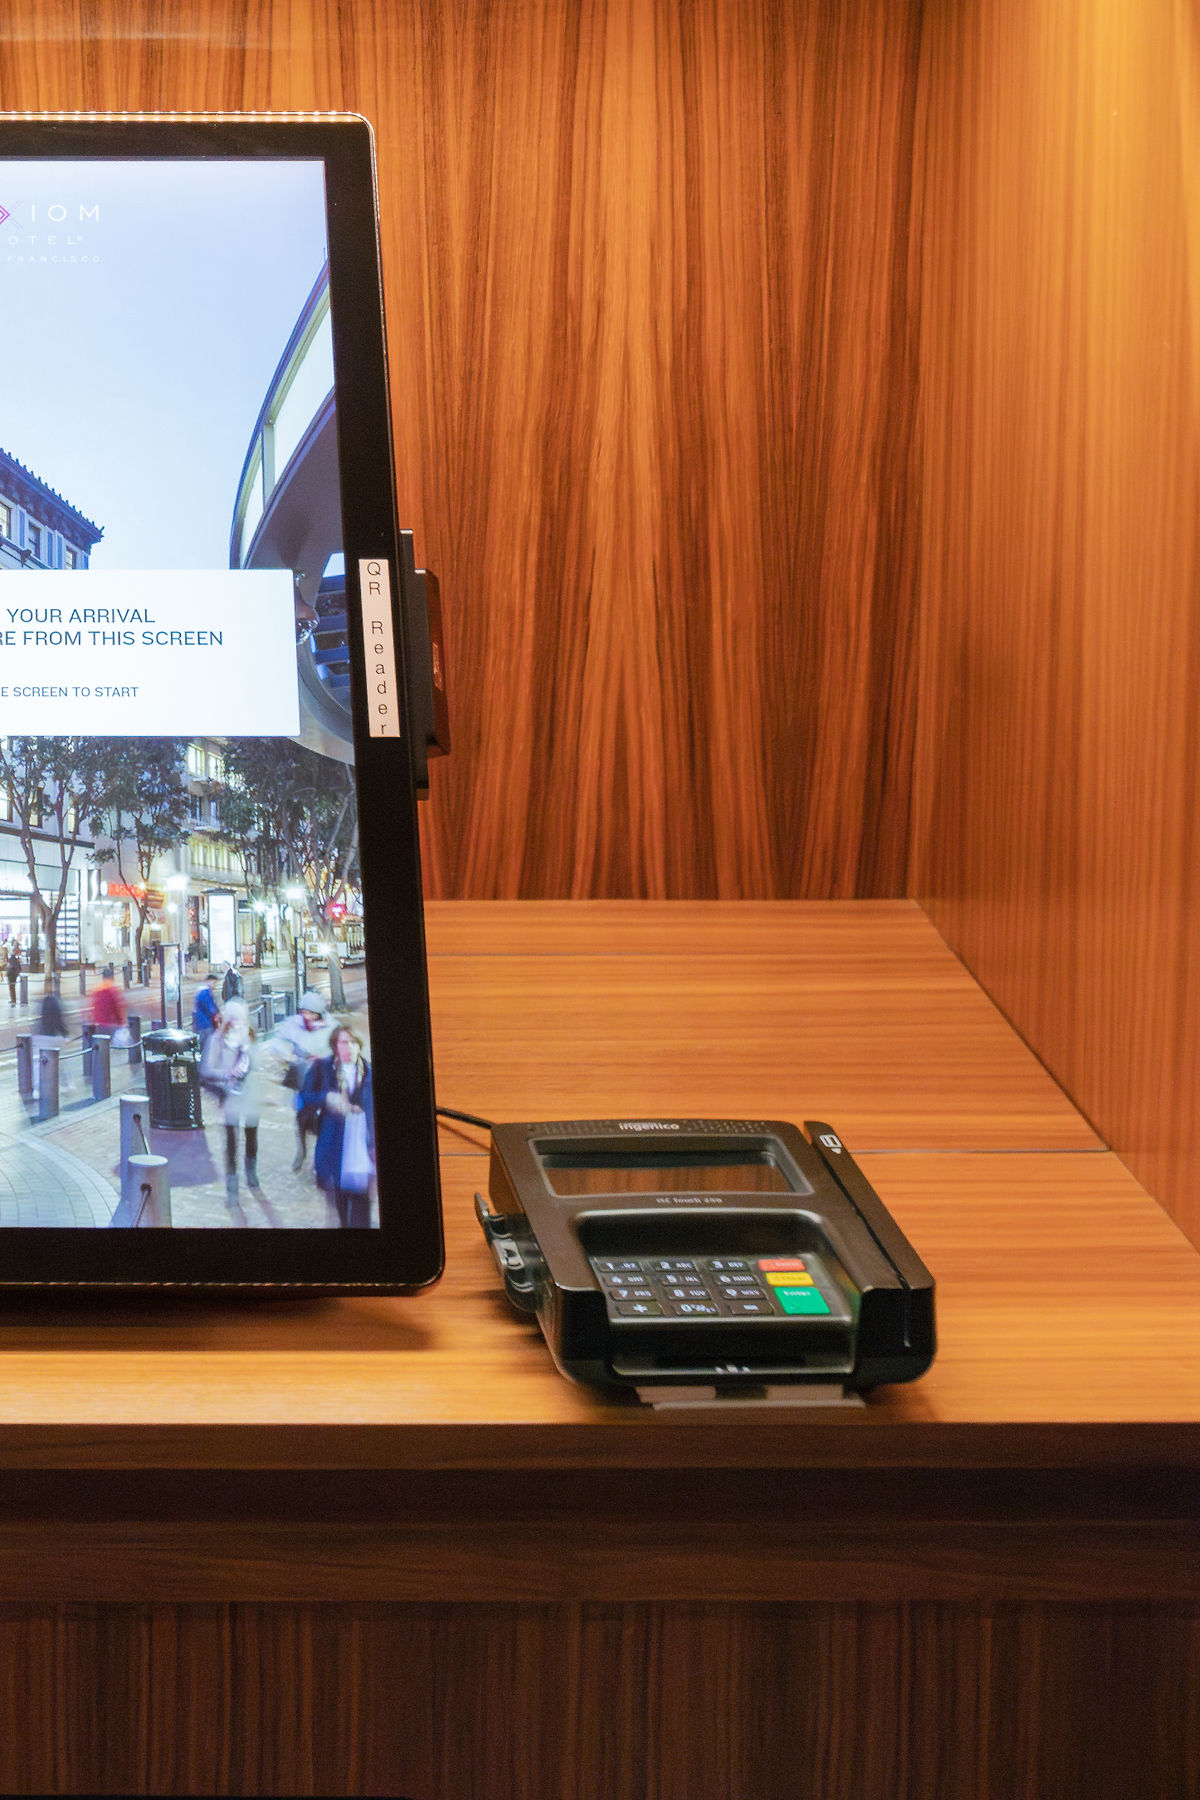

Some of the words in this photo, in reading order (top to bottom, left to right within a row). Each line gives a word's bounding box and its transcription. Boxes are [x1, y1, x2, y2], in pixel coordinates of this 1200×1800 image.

[7, 608, 62, 623] YOUR
[69, 608, 156, 623] ARRIVAL
[24, 631, 82, 646] FROM
[88, 631, 135, 646] THIS
[142, 631, 224, 646] SCREEN
[13, 686, 68, 698] SCREEN
[72, 686, 91, 698] TO
[94, 686, 139, 698] START
[618, 1122, 680, 1132] ingenico
